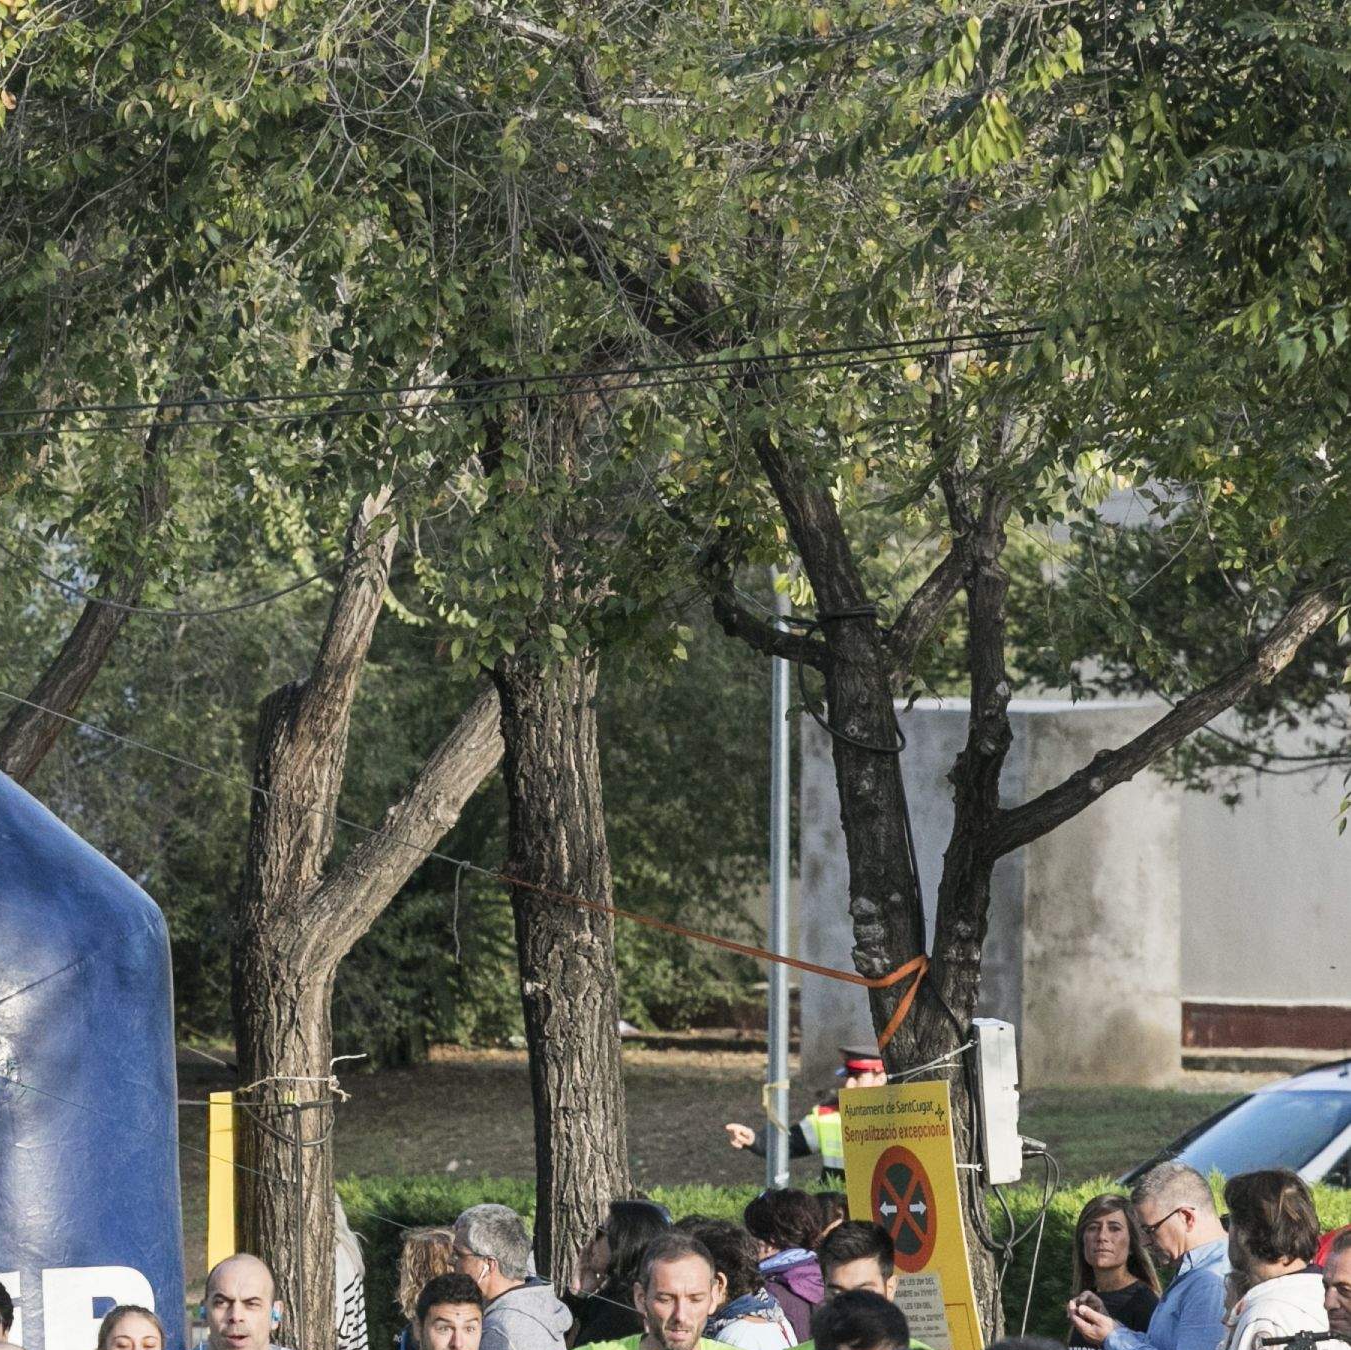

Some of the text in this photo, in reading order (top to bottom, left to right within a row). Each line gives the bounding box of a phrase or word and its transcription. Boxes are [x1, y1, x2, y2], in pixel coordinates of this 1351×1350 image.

[844, 1099, 934, 1119] Ajuntament de SantCugat
[844, 1121, 949, 1145] Senyalització excepcional
